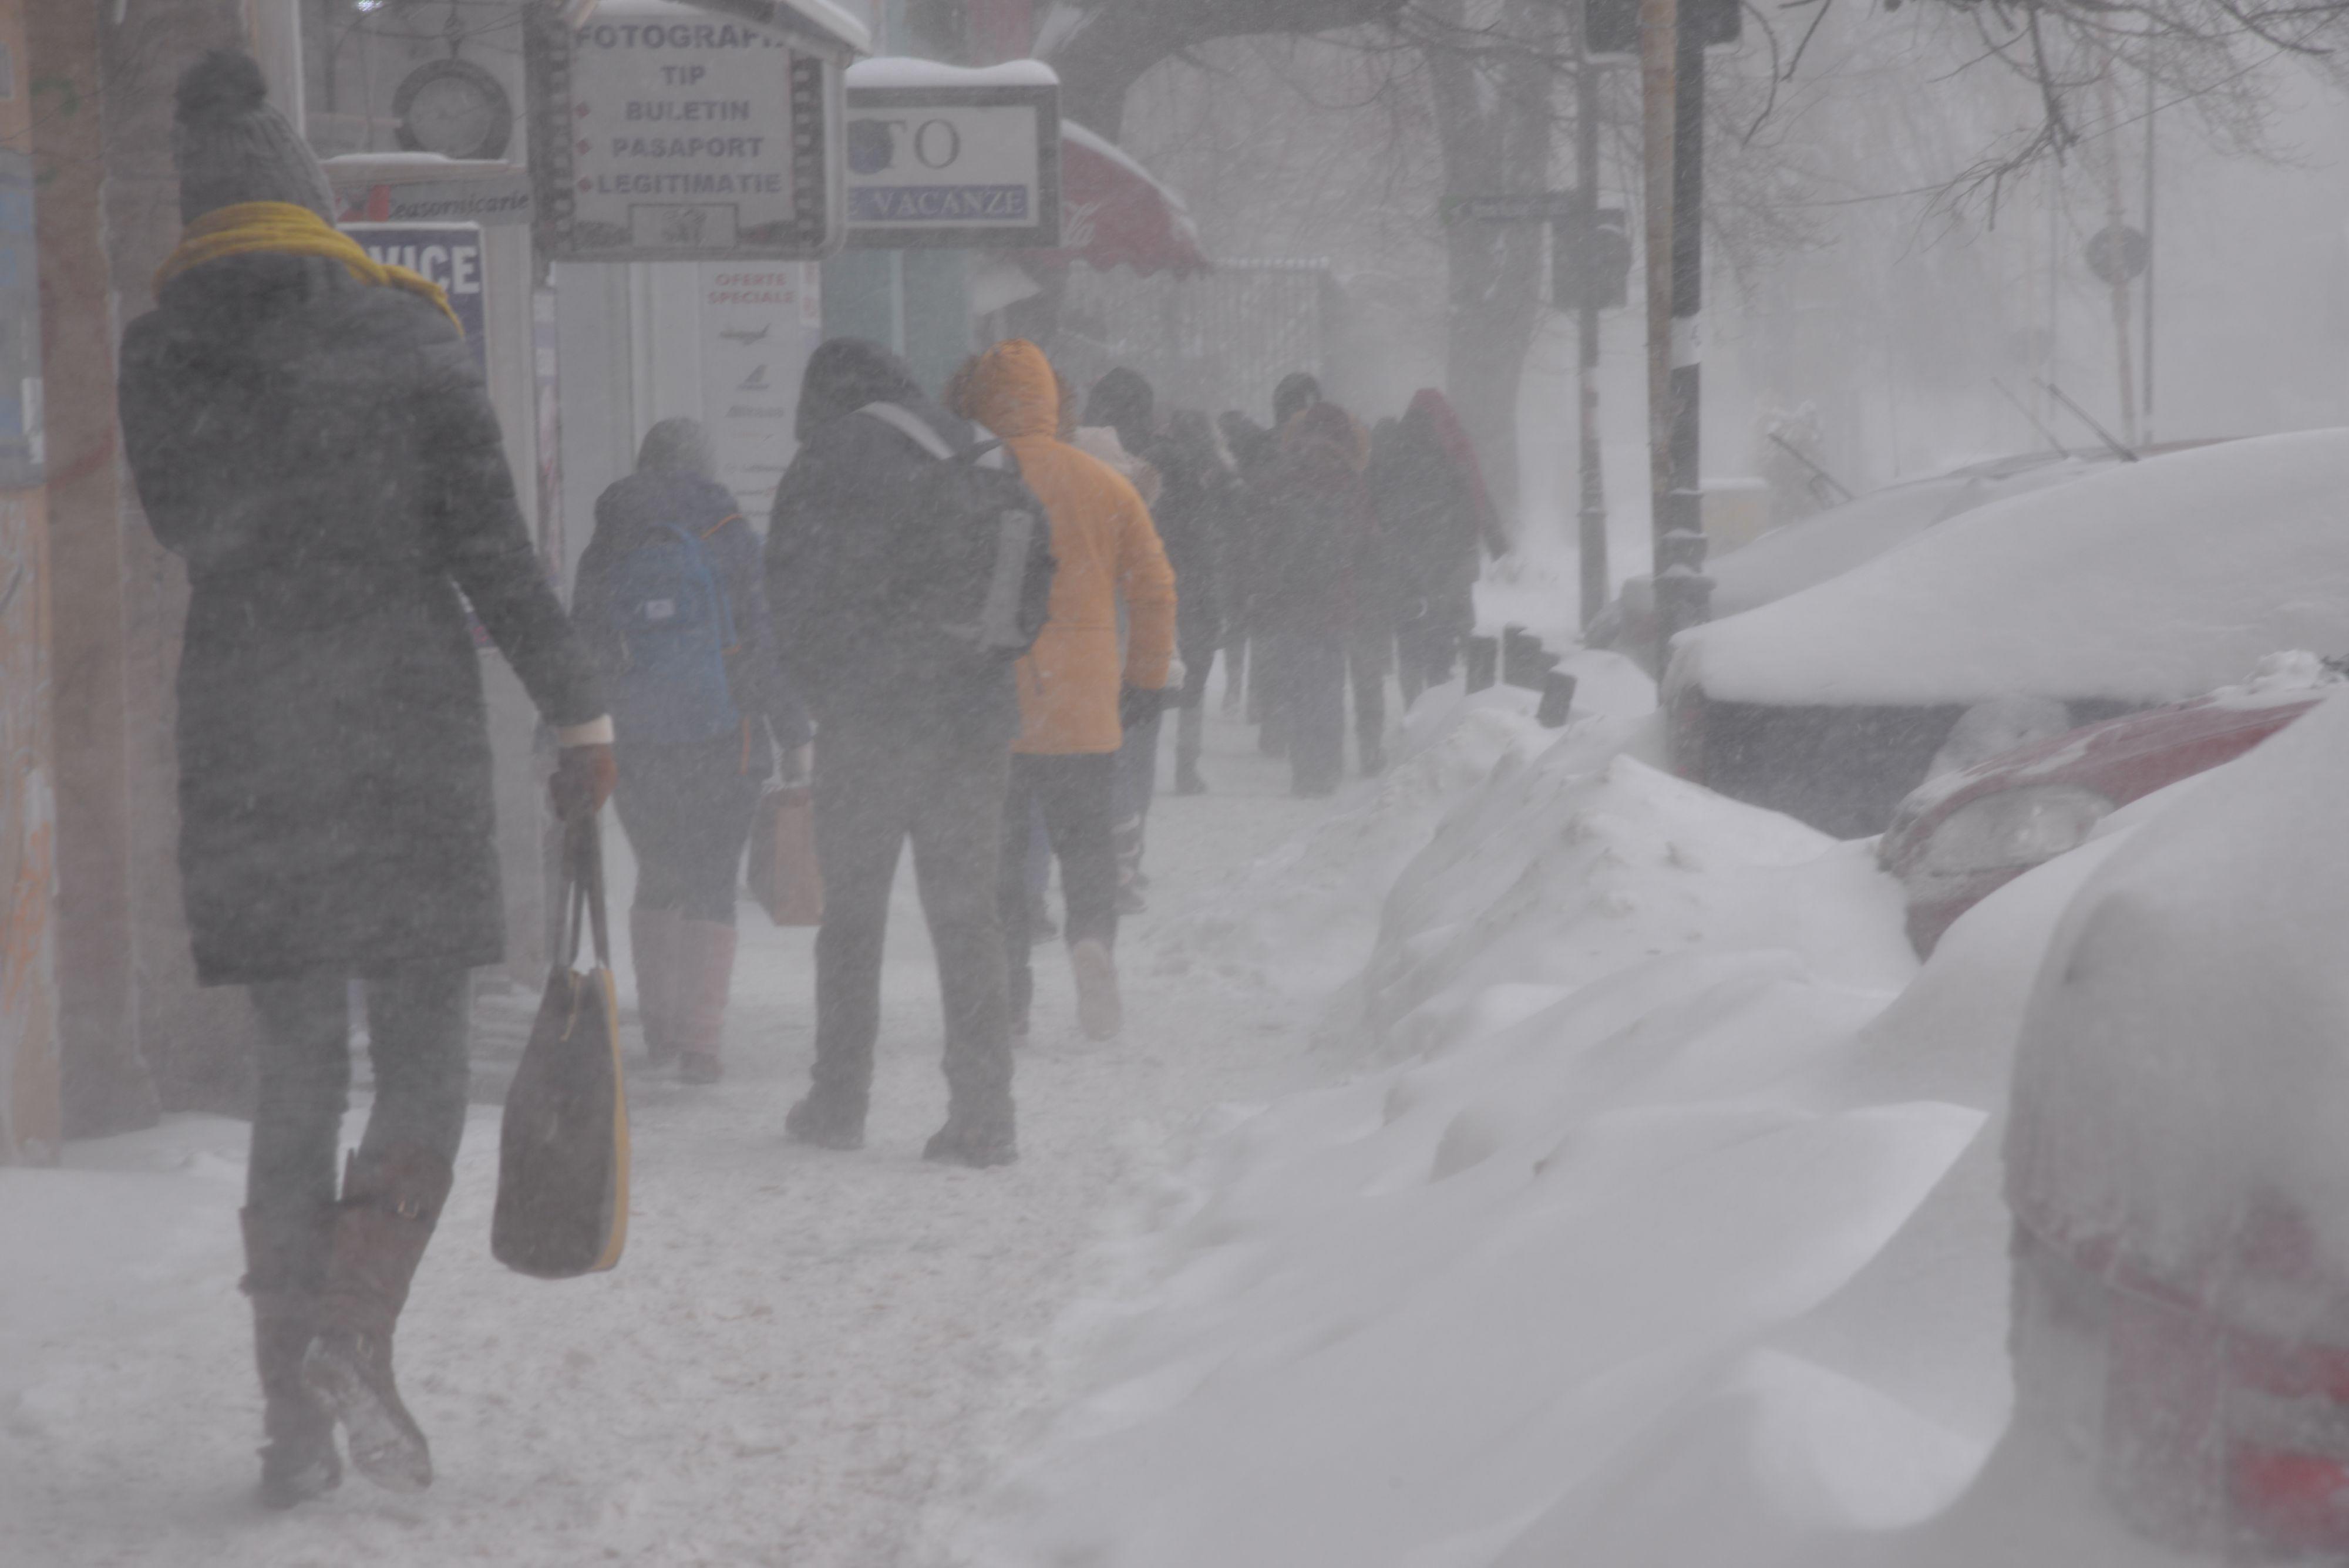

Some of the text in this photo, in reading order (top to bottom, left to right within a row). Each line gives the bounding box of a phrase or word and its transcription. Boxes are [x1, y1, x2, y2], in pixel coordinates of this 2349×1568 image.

[575, 23, 785, 49] FOTOGRAF
[660, 65, 706, 86] TIP
[625, 100, 749, 121] BULETIN
[612, 137, 765, 158] PASAPORT
[597, 174, 782, 194] LEGITIMATIE
[873, 189, 1024, 216] VACANZE
